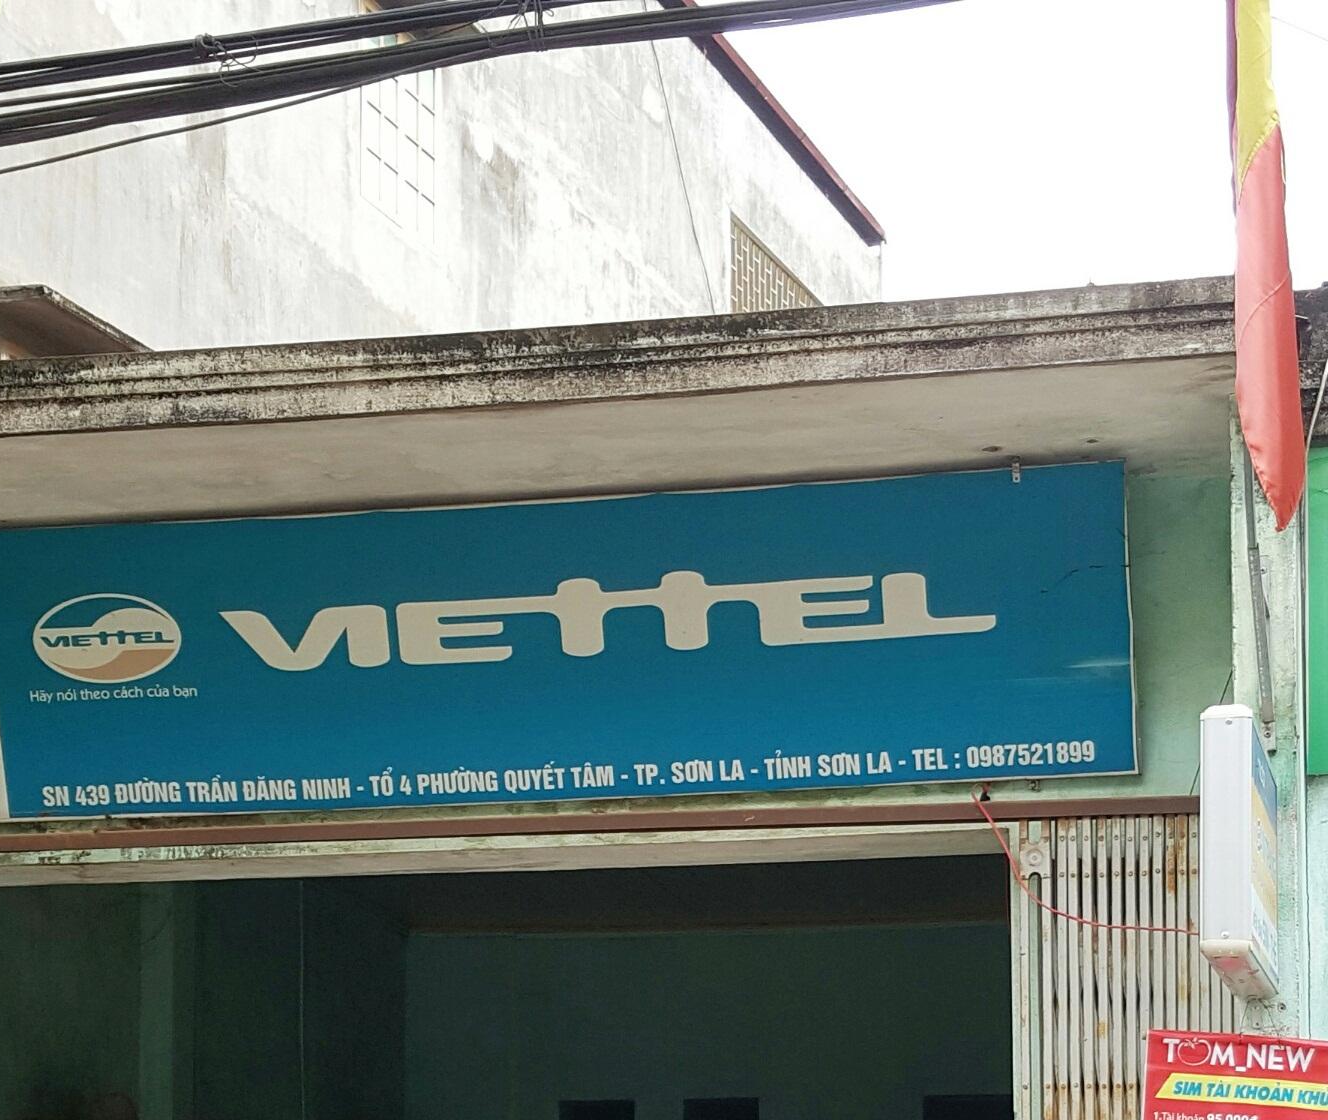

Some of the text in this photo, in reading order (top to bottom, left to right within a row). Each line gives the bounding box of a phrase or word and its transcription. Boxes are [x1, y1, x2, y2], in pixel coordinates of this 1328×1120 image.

[29, 684, 198, 704] Hãy nói theo cách của bạn
[42, 740, 1096, 807] SN 439 ĐƯỜNG TRẦN ĐĂNG NINH TỔ 4 PHƯỜNG QUYẾT TÂM TP. SƠN LA TỈNH SƠN LA TEL 0987521899
[1173, 1081, 1202, 1096] SIM
[1207, 1080, 1231, 1098] TÀI
[1235, 1081, 1293, 1102] KHOẢN
